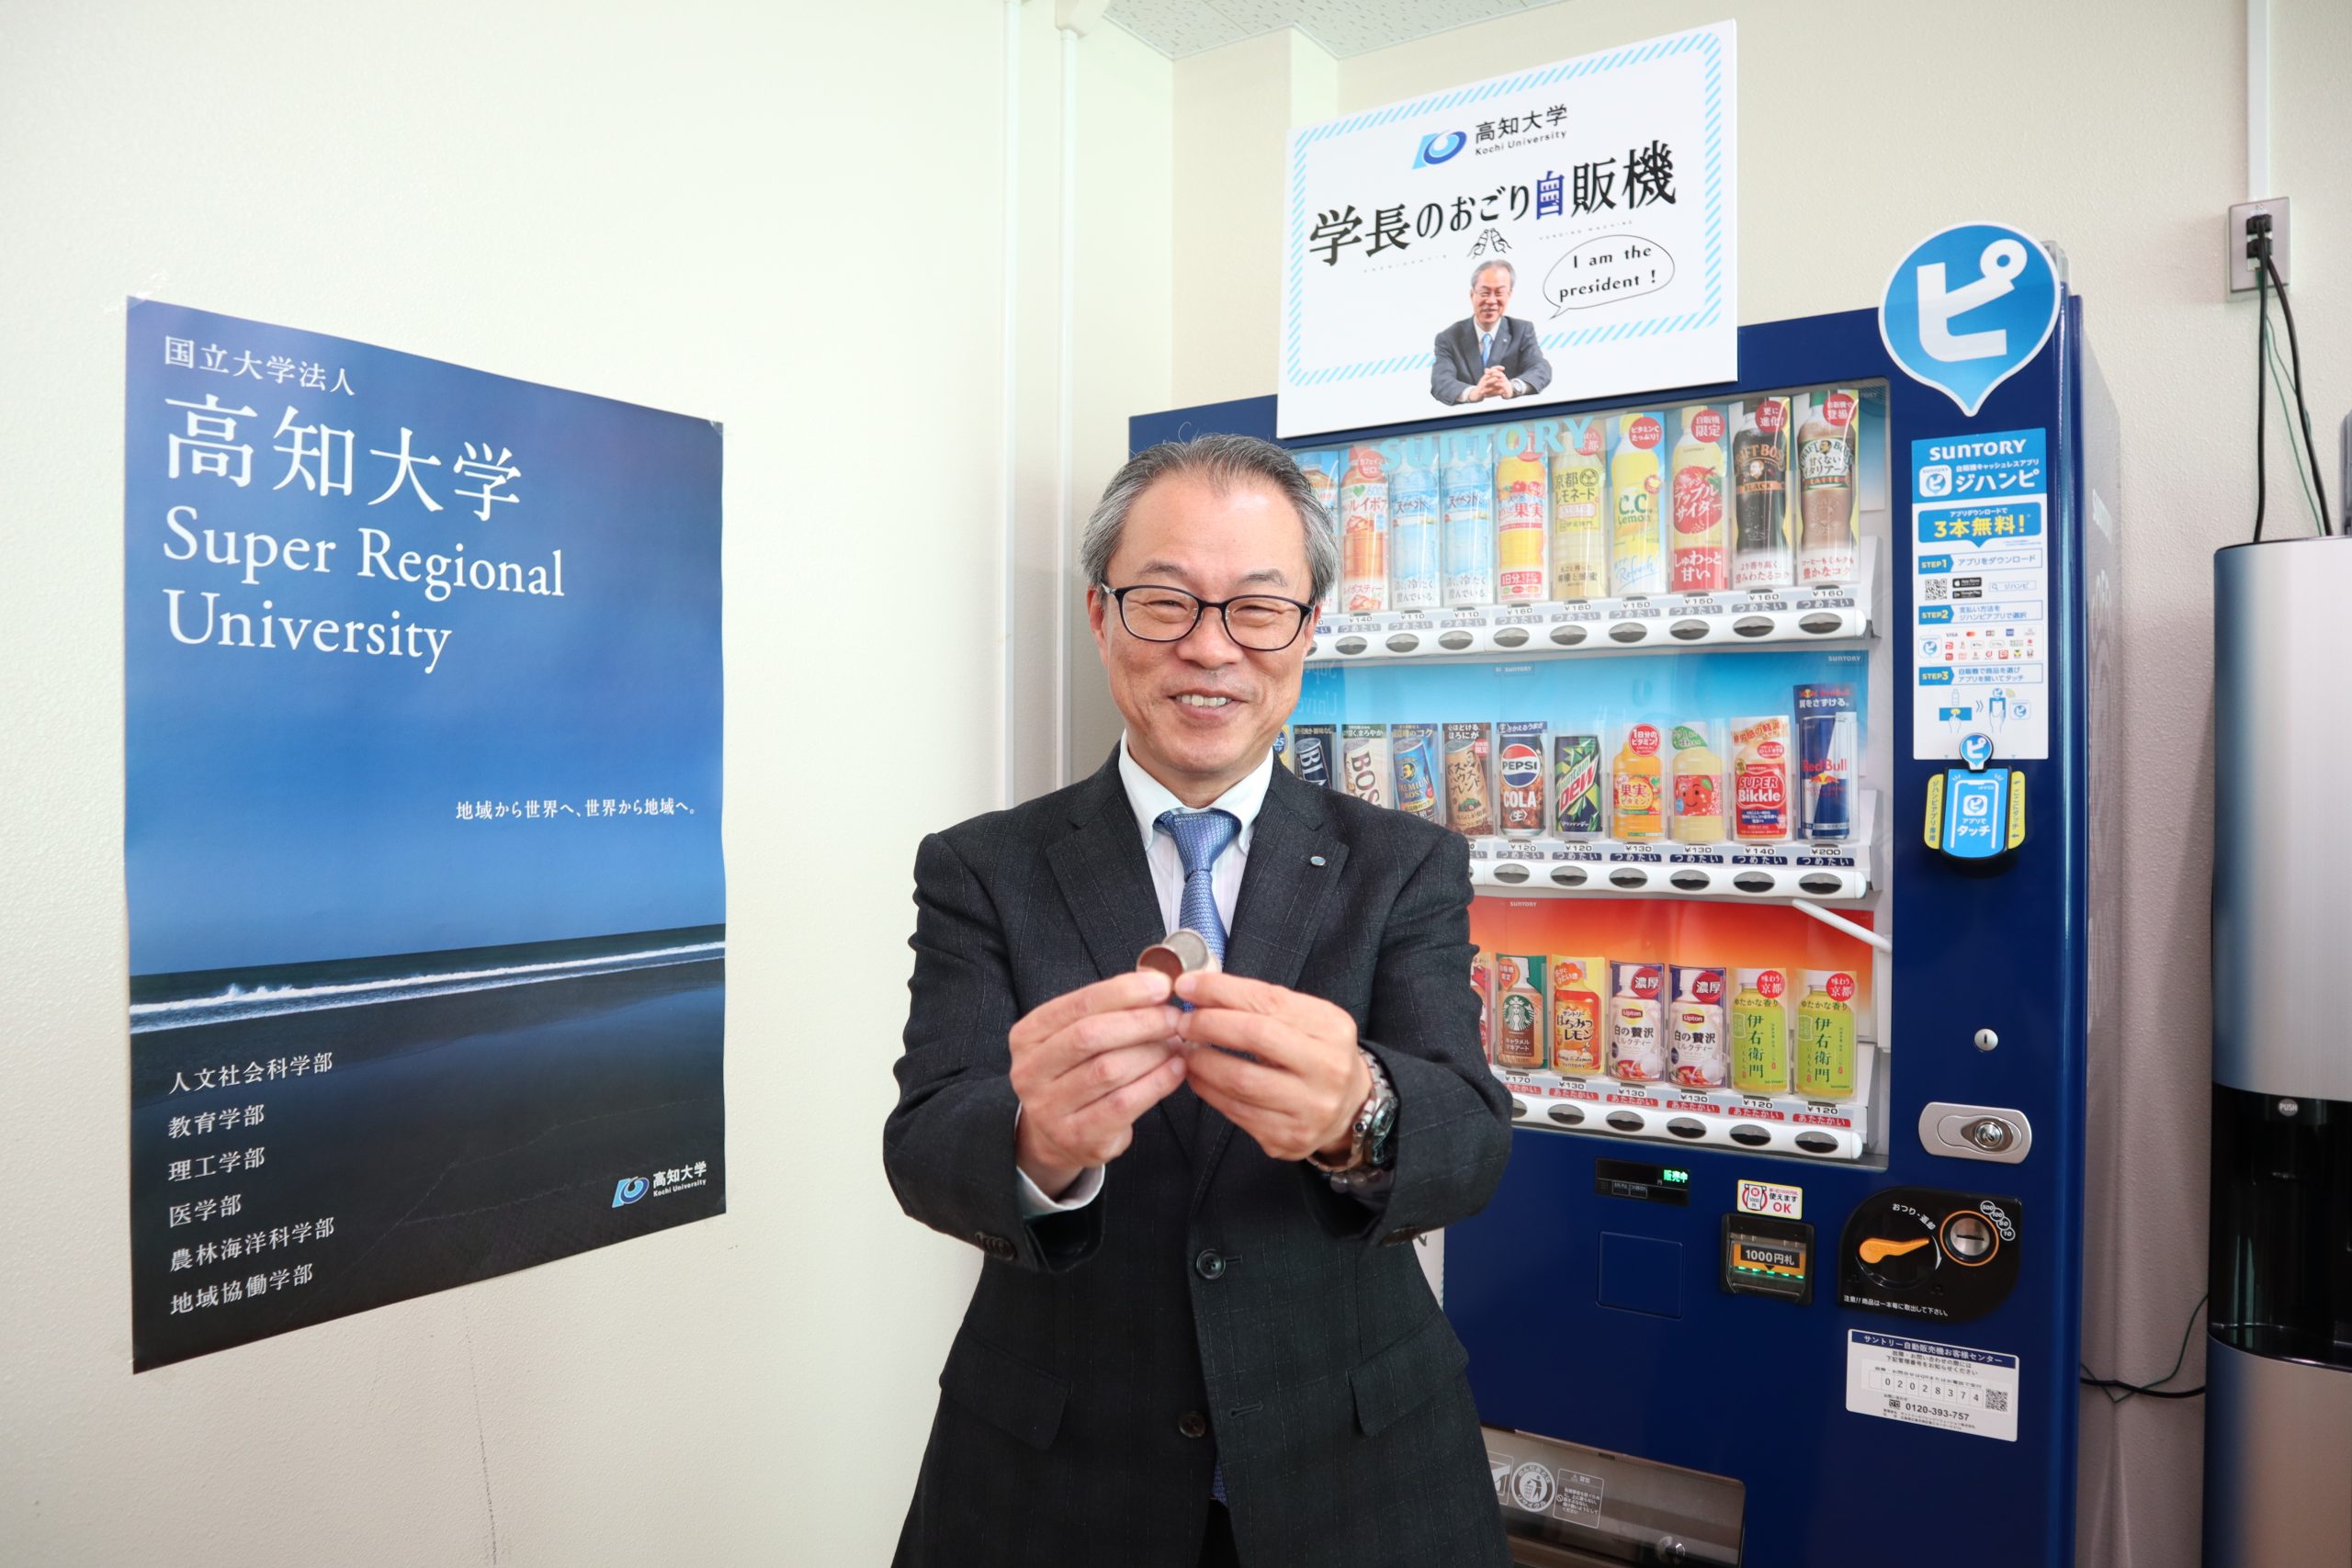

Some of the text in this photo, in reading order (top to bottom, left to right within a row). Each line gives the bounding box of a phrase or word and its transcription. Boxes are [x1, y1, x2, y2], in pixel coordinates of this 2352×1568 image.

[1475, 104, 1568, 144] 高知大学
[1476, 130, 1567, 156] Kochi University
[1308, 140, 1677, 266] 学長のおごり自販機
[1573, 244, 1652, 268] I am the
[1559, 275, 1641, 302] president
[1917, 238, 2028, 363] ピ
[164, 335, 356, 397] 国立大学法人
[1696, 415, 1720, 424] 自販機
[1696, 425, 1720, 437] 限定
[1929, 439, 2028, 461] SUNTORY
[164, 393, 521, 522] 高知大学
[1555, 471, 1578, 490] 京都
[1955, 468, 2041, 492] ジハンピ
[1557, 488, 1595, 503] レモネード
[1933, 514, 2025, 537] 3本無料!
[164, 506, 565, 602] Super Regional
[1674, 550, 1722, 567] しゅわっと
[1958, 555, 2037, 566] アプリをダウンロード
[1680, 567, 1711, 582] 甘い
[1802, 599, 1849, 609] つめたい
[163, 589, 452, 674] University
[1634, 728, 1657, 738] 1日分の
[1632, 737, 1658, 746] ビタミン!
[1502, 761, 1537, 771] PEPSI
[1351, 750, 1382, 807] BOS
[1739, 777, 1779, 789] SUPER
[1503, 791, 1537, 808] COLA
[1738, 789, 1781, 802] Bikkle
[456, 796, 695, 820] 地域から世界へ、世界から地域へ。
[1957, 825, 1991, 837] タッチ
[1500, 852, 1541, 860] つめたい
[1674, 854, 1719, 863] つめたい
[1737, 856, 1784, 864] つめたい
[1803, 857, 1850, 866] つめたい
[1634, 976, 1659, 989] 濃厚
[1696, 981, 1721, 994] 濃厚
[1761, 984, 1782, 994] 京都
[1831, 987, 1852, 997] 京都
[1735, 998, 1779, 1008] ゆたかな香り
[1801, 1001, 1849, 1010] ゆたかな香り
[1623, 1009, 1643, 1017] Lipton
[1683, 1014, 1703, 1022] Lipton
[1556, 1014, 1593, 1029] はちみつ
[1564, 1030, 1594, 1041] レモン
[1614, 1024, 1655, 1039] 白の贅沢
[1674, 1030, 1716, 1044] 白の贅沢
[1747, 1013, 1765, 1079] 伊右衛門
[1815, 1016, 1832, 1083] 伊右衛門
[168, 1052, 333, 1095] 人文社会科学部
[1505, 1076, 1531, 1084] ¥170
[1559, 1081, 1585, 1090] ¥130
[1554, 1089, 1595, 1100] あたたかい
[1619, 1089, 1645, 1098] ¥130
[1680, 1094, 1708, 1103] ¥130
[1611, 1095, 1655, 1107] あたたかい
[1672, 1101, 1716, 1112] あたたかい
[1743, 1100, 1773, 1109] ¥120
[2278, 1103, 2298, 1111] PUSH
[1733, 1108, 1781, 1120] あたたかい
[1807, 1106, 1838, 1115] ¥120
[168, 1103, 266, 1139] 教育学部
[1798, 1114, 1846, 1127] あたたかい
[168, 1146, 266, 1182] 理工学部
[652, 1161, 707, 1189] 高知大学
[1664, 1169, 1688, 1183] 販売中
[653, 1179, 707, 1197] Kochi University
[169, 1194, 242, 1228] 医学部
[1773, 1202, 1792, 1213] OK
[170, 1217, 334, 1272] 農林海洋科学部
[1745, 1249, 1795, 1266] 1000円札
[170, 1263, 313, 1314] 地域協働学部
[1863, 1335, 2003, 1364] サントリー自動販売機お客様センター
[1905, 1403, 1970, 1421] 0120-393-757
